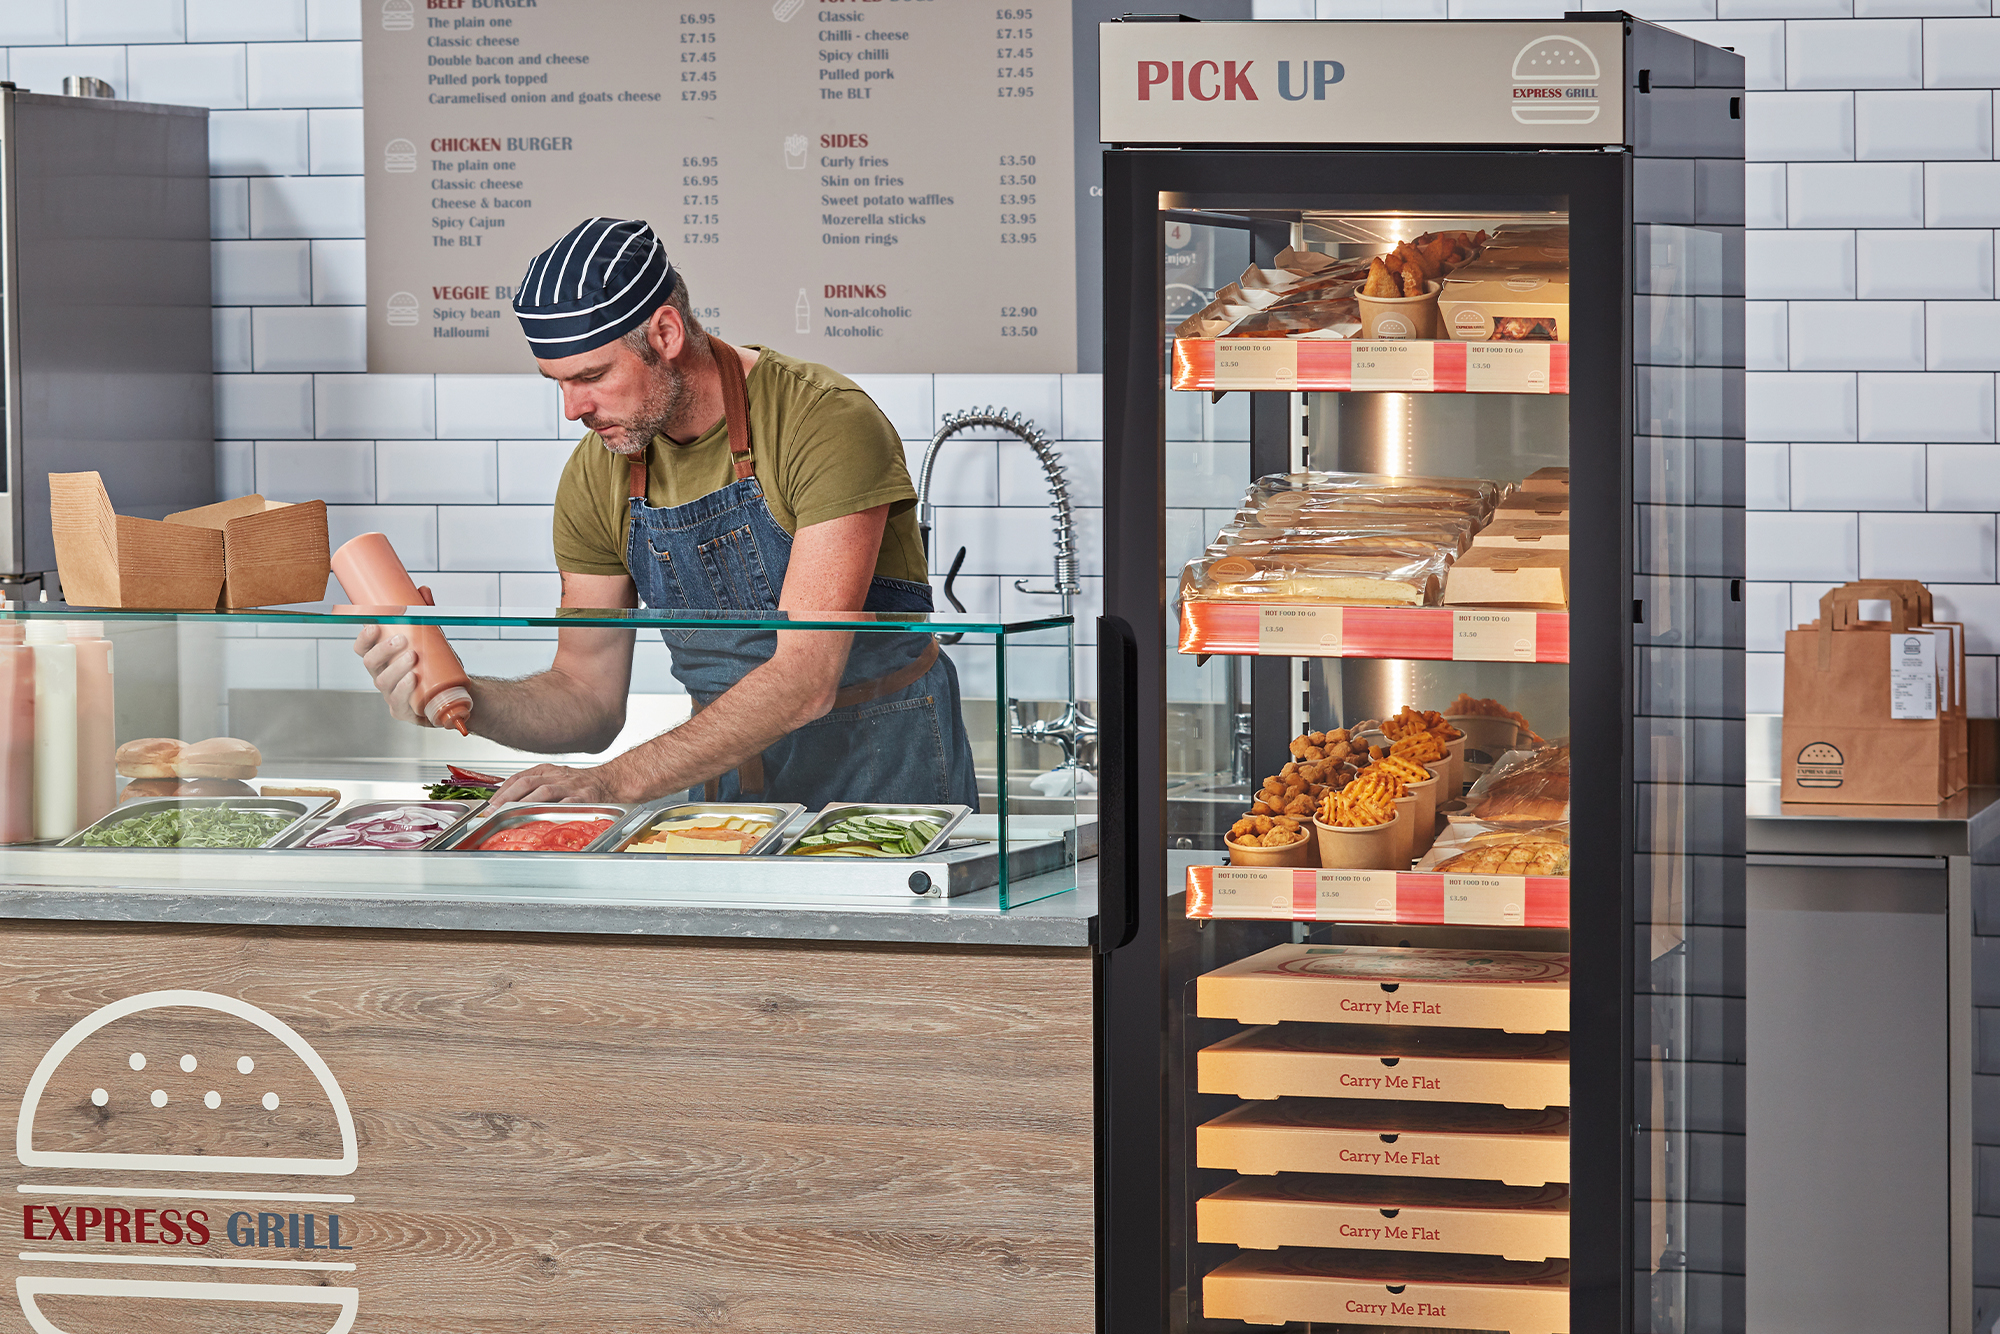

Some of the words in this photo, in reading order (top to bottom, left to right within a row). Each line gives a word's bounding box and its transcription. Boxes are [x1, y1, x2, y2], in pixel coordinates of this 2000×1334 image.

[680, 13, 716, 24] £6.95
[818, 10, 864, 22] Classic
[996, 9, 1033, 20] £6.95
[427, 17, 450, 28] The
[454, 16, 485, 30] plain
[489, 19, 512, 27] one
[680, 33, 716, 43] £7.15
[818, 30, 852, 41] Chilli
[864, 30, 909, 41] cheese
[996, 28, 1033, 39] £7.15
[427, 36, 471, 47] Classic
[476, 35, 519, 46] cheese
[681, 52, 716, 63] £7.45
[819, 49, 852, 63] Spicy
[857, 49, 889, 60] chilli
[997, 48, 1033, 58] £7.45
[428, 55, 472, 66] Double
[476, 54, 514, 65] bacon
[518, 54, 542, 65] and
[545, 53, 589, 64] cheese
[681, 71, 717, 82] £7.45
[819, 69, 859, 80] Pulled
[864, 68, 894, 82] pork
[997, 67, 1033, 78] £7.45
[428, 74, 467, 85] Pulled
[472, 73, 501, 87] pork
[505, 73, 548, 86] topped
[1137, 60, 1259, 101] PICK
[1278, 60, 1345, 101] UP
[428, 92, 507, 104] Caramelised
[511, 92, 546, 103] onion
[551, 91, 574, 103] and
[578, 92, 613, 104] goats
[617, 91, 661, 102] cheese
[681, 90, 717, 101] £7.95
[820, 88, 843, 99] The
[847, 88, 871, 99] BLT
[998, 87, 1034, 97] £7.95
[1513, 88, 1562, 98] EXPRESS
[1565, 88, 1598, 98] GRILL
[430, 138, 501, 152] CHICKEN
[507, 137, 572, 151] BURGER
[820, 134, 868, 148] SIDES
[431, 160, 453, 171] The
[457, 159, 489, 173] plain
[493, 162, 516, 170] one
[683, 156, 718, 167] £6.95
[820, 156, 854, 169] Curly
[859, 156, 889, 167] fries
[999, 155, 1036, 166] £3.50
[431, 179, 475, 190] Classic
[480, 178, 523, 189] cheese
[683, 175, 718, 186] £6.95
[821, 175, 849, 186] Skin
[854, 178, 870, 186] on
[874, 175, 904, 186] fries
[1000, 175, 1036, 185] £3.50
[431, 198, 476, 209] Cheese
[480, 198, 489, 208] &
[494, 197, 531, 208] bacon
[683, 195, 719, 205] £7.15
[821, 195, 858, 206] Sweet
[863, 195, 904, 208] potato
[908, 194, 954, 205] waffles
[1000, 194, 1036, 205] £3.95
[432, 217, 464, 230] Spicy
[469, 216, 505, 230] Cajun
[684, 214, 719, 224] £7.15
[822, 213, 884, 225] Mozerella
[888, 213, 926, 224] sticks
[1000, 213, 1036, 224] £3.95
[684, 233, 719, 244] £7.95
[1001, 233, 1037, 244] £3.95
[1172, 226, 1181, 240] 4
[433, 236, 455, 247] The
[459, 235, 482, 246] BLT
[822, 233, 860, 244] Onion
[865, 233, 898, 246] rings
[432, 286, 489, 300] VEGGIE
[824, 284, 886, 298] DRINKS
[433, 308, 465, 320] Spicy
[470, 308, 500, 319] bean
[692, 307, 720, 318] 6.95
[824, 306, 912, 318] Non-alcoholic
[1001, 307, 1037, 317] £2.90
[433, 327, 489, 338] Halloumi
[824, 326, 883, 337] Alcoholic
[1001, 326, 1038, 337] £3.50
[1340, 999, 1382, 1015] Carry
[1385, 1000, 1409, 1013] Me
[1412, 1001, 1441, 1014] Flat
[1340, 1074, 1382, 1090] Carry
[1385, 1075, 1408, 1088] Me
[1412, 1076, 1440, 1090] Flat
[1339, 1149, 1381, 1165] Carry
[1384, 1151, 1408, 1164] Me
[1411, 1152, 1440, 1165] Flat
[24, 1205, 210, 1245] EXPRESS
[226, 1212, 353, 1250] GRILL
[1339, 1224, 1381, 1240] Carry
[1384, 1226, 1408, 1239] Me
[1411, 1227, 1440, 1241] Flat
[1345, 1300, 1387, 1316] Carry
[1391, 1302, 1414, 1315] Me
[1417, 1303, 1446, 1317] Flat
